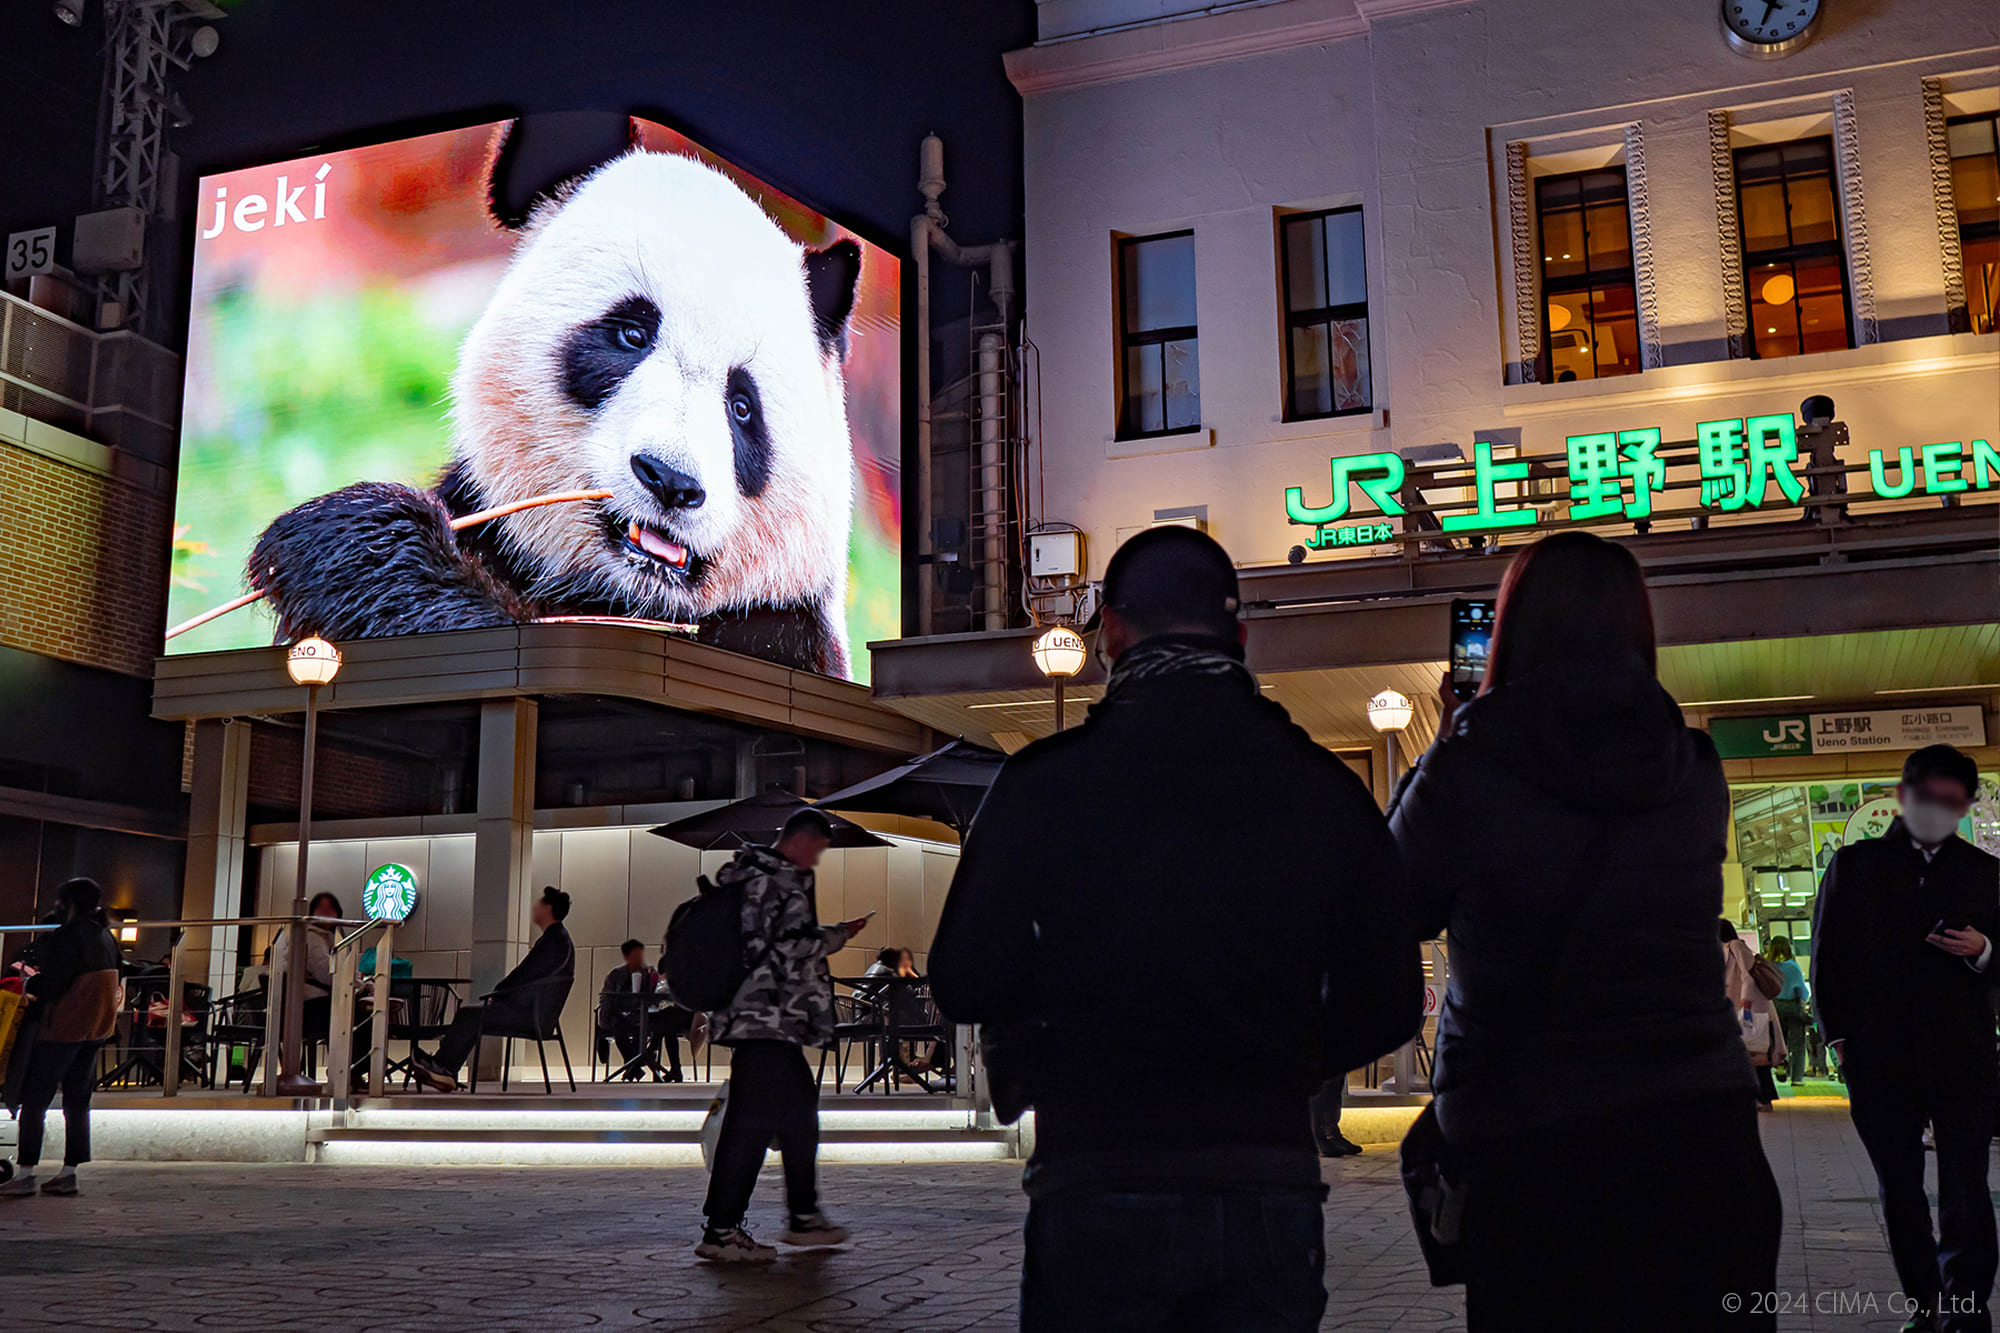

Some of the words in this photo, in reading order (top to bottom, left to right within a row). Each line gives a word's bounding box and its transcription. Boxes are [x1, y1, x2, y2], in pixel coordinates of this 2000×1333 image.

[1754, 27, 1763, 35] 7
[11, 234, 50, 272] 35
[1285, 452, 1407, 524] JR
[1442, 412, 1806, 532] 上野駅
[1868, 439, 2000, 498] UEN
[1305, 522, 1393, 548] JR東日本
[1816, 716, 1872, 735] 上野駅
[1902, 712, 1952, 725] 広小路口
[1763, 720, 1807, 743] JR
[1817, 736, 1847, 748] Ueno
[1850, 735, 1891, 746] Station
